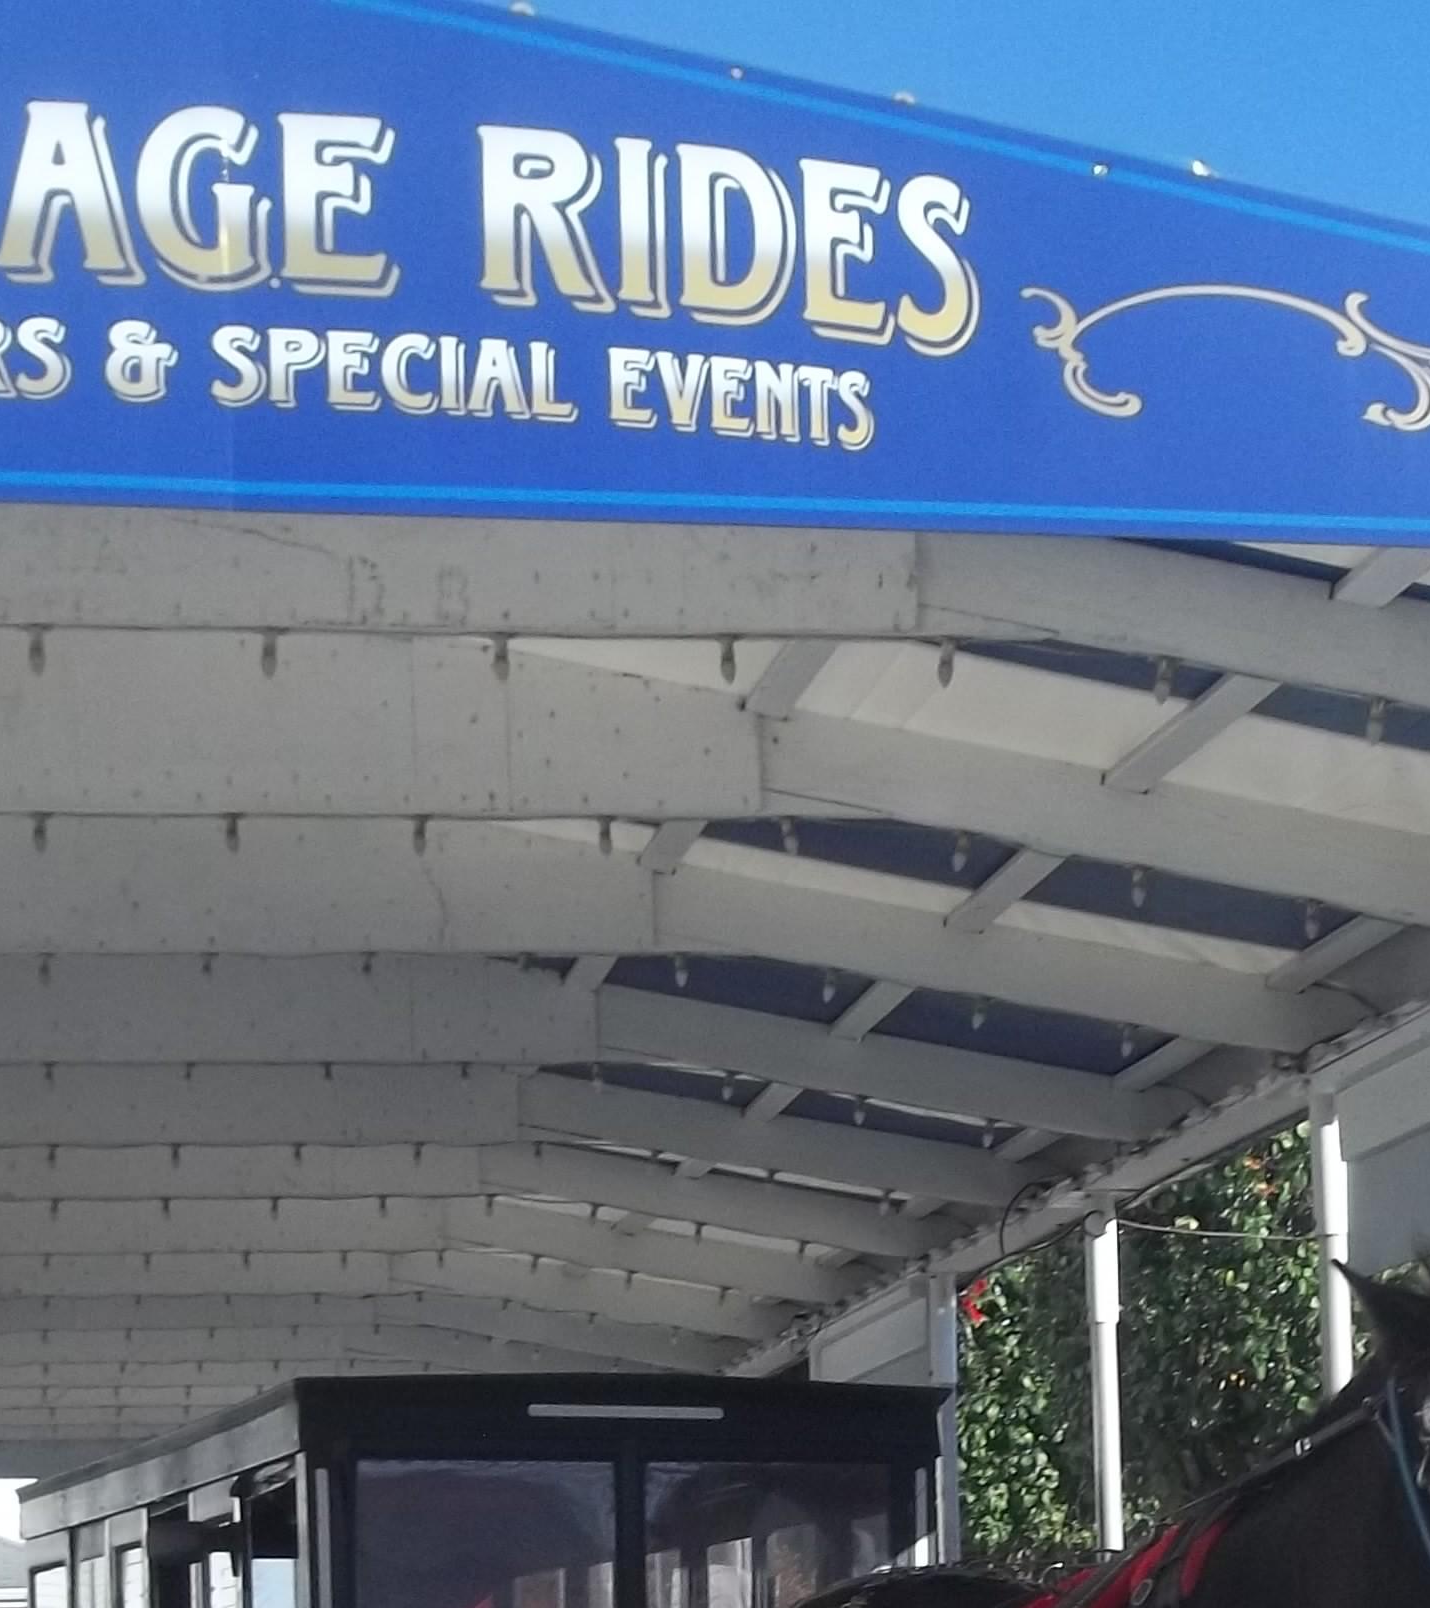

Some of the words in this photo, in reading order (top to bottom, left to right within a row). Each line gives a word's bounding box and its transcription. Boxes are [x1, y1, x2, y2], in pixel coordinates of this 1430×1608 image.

[477, 124, 980, 358] RIDES
[103, 318, 177, 403] &
[210, 324, 579, 424] SPECIAL
[607, 347, 876, 452] EVENTS
